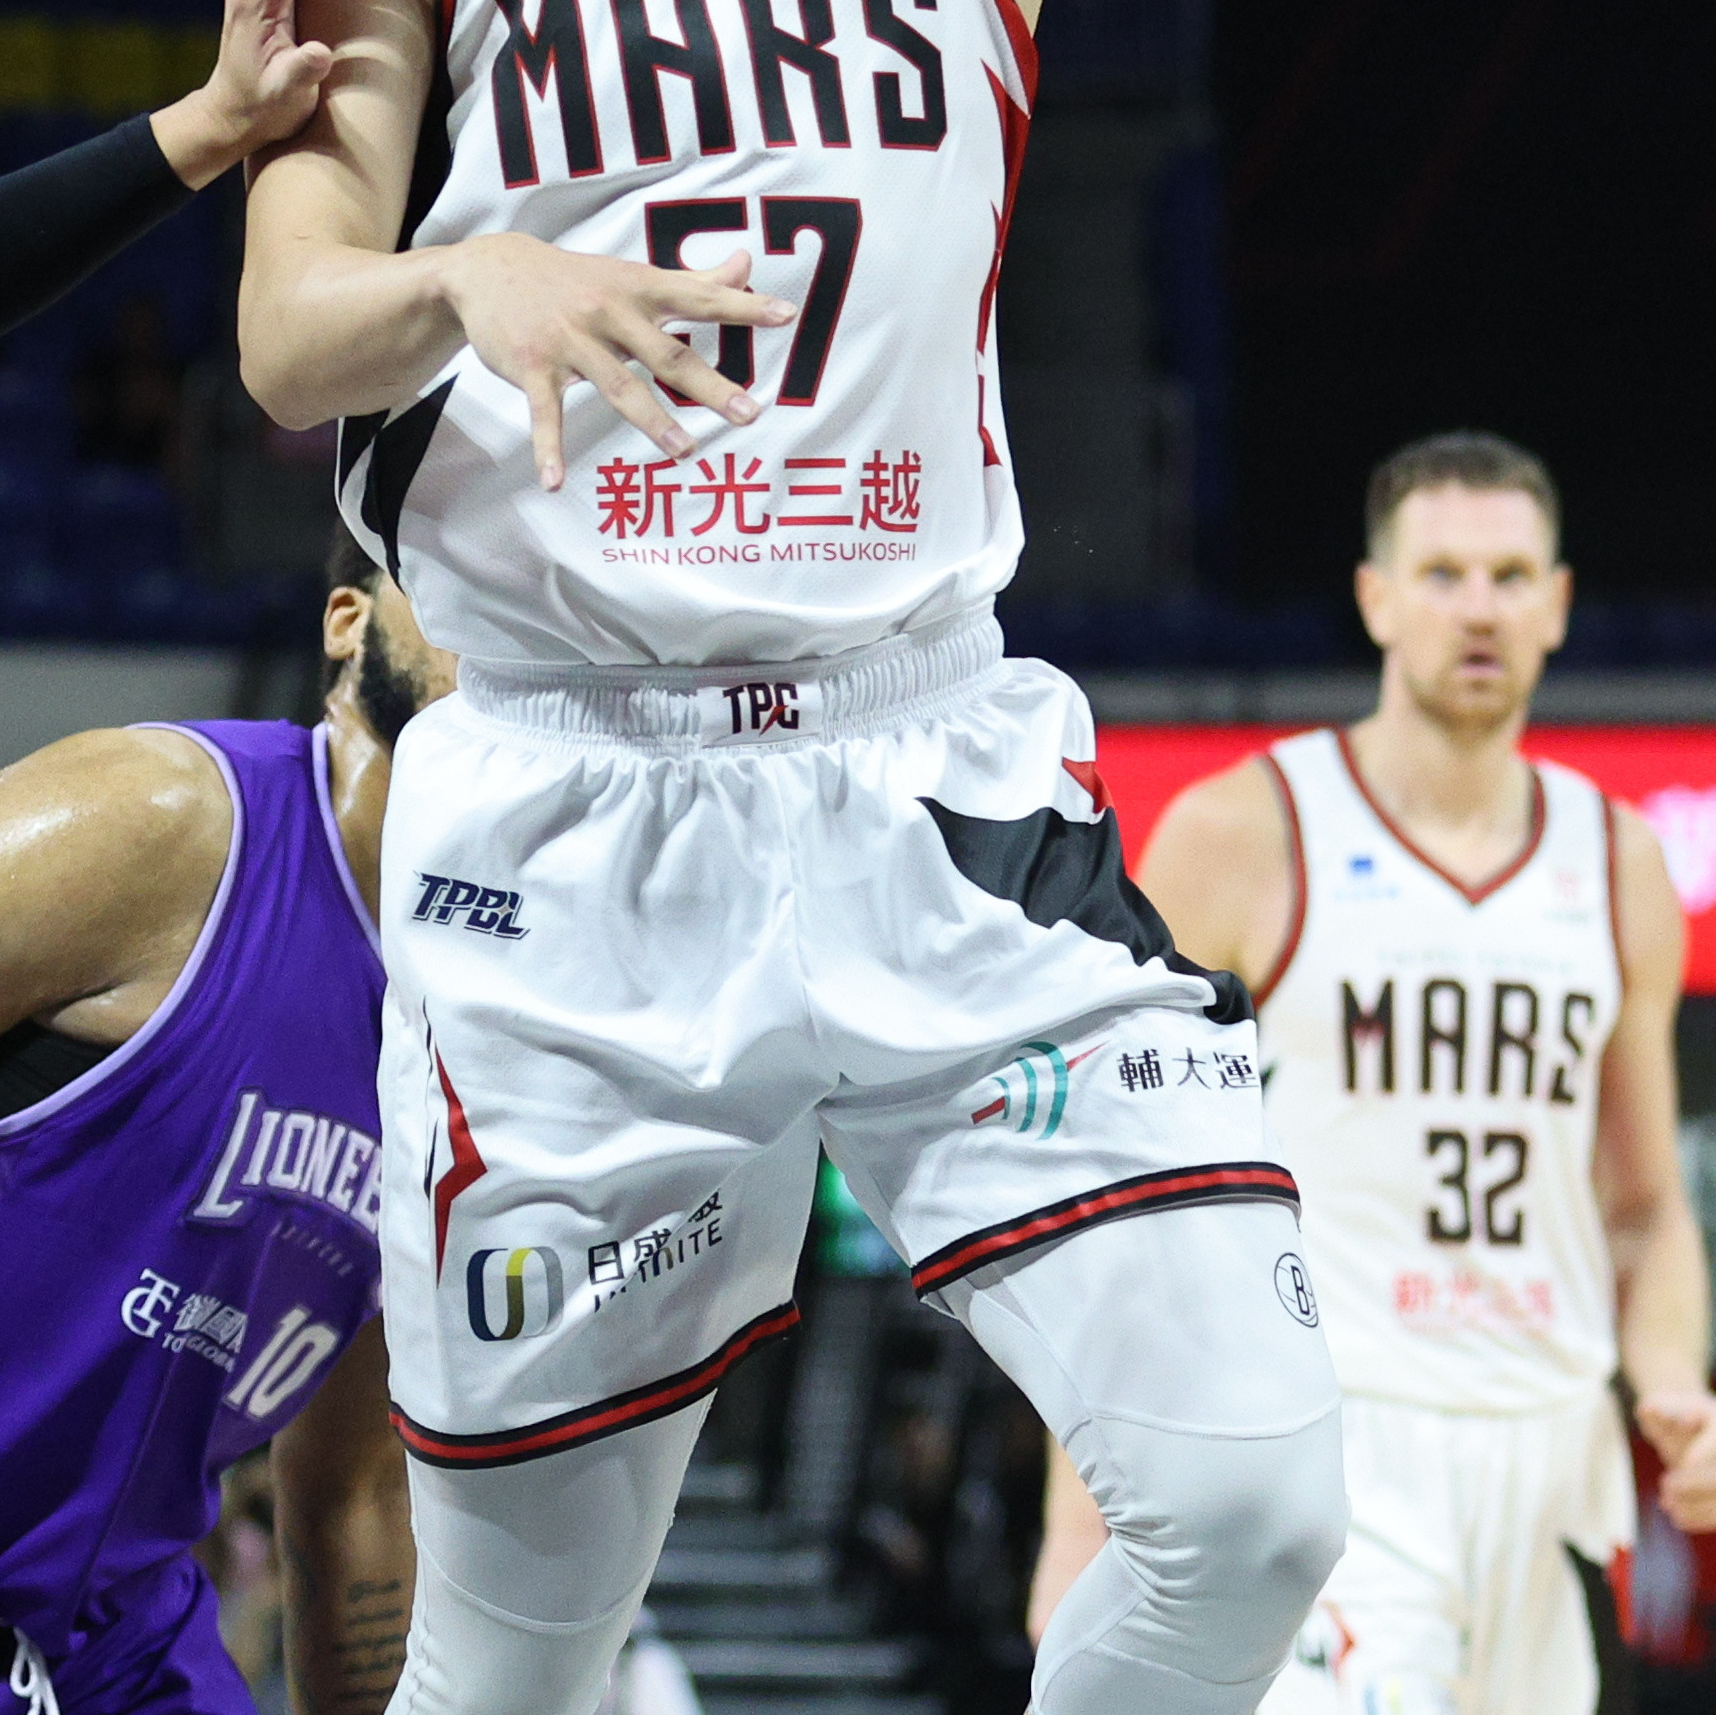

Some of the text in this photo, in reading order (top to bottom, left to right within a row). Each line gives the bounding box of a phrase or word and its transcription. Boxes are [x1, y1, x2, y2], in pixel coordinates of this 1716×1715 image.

[643, 195, 863, 407] 57
[596, 450, 922, 539] 新光三越
[602, 541, 917, 565] SHIN KONG MITSUKOSHI
[723, 682, 800, 735] TPC
[412, 871, 530, 940] TPBL
[1340, 977, 1595, 1104] MARS
[1427, 1130, 1528, 1245] 32
[225, 1306, 340, 1419] 10
